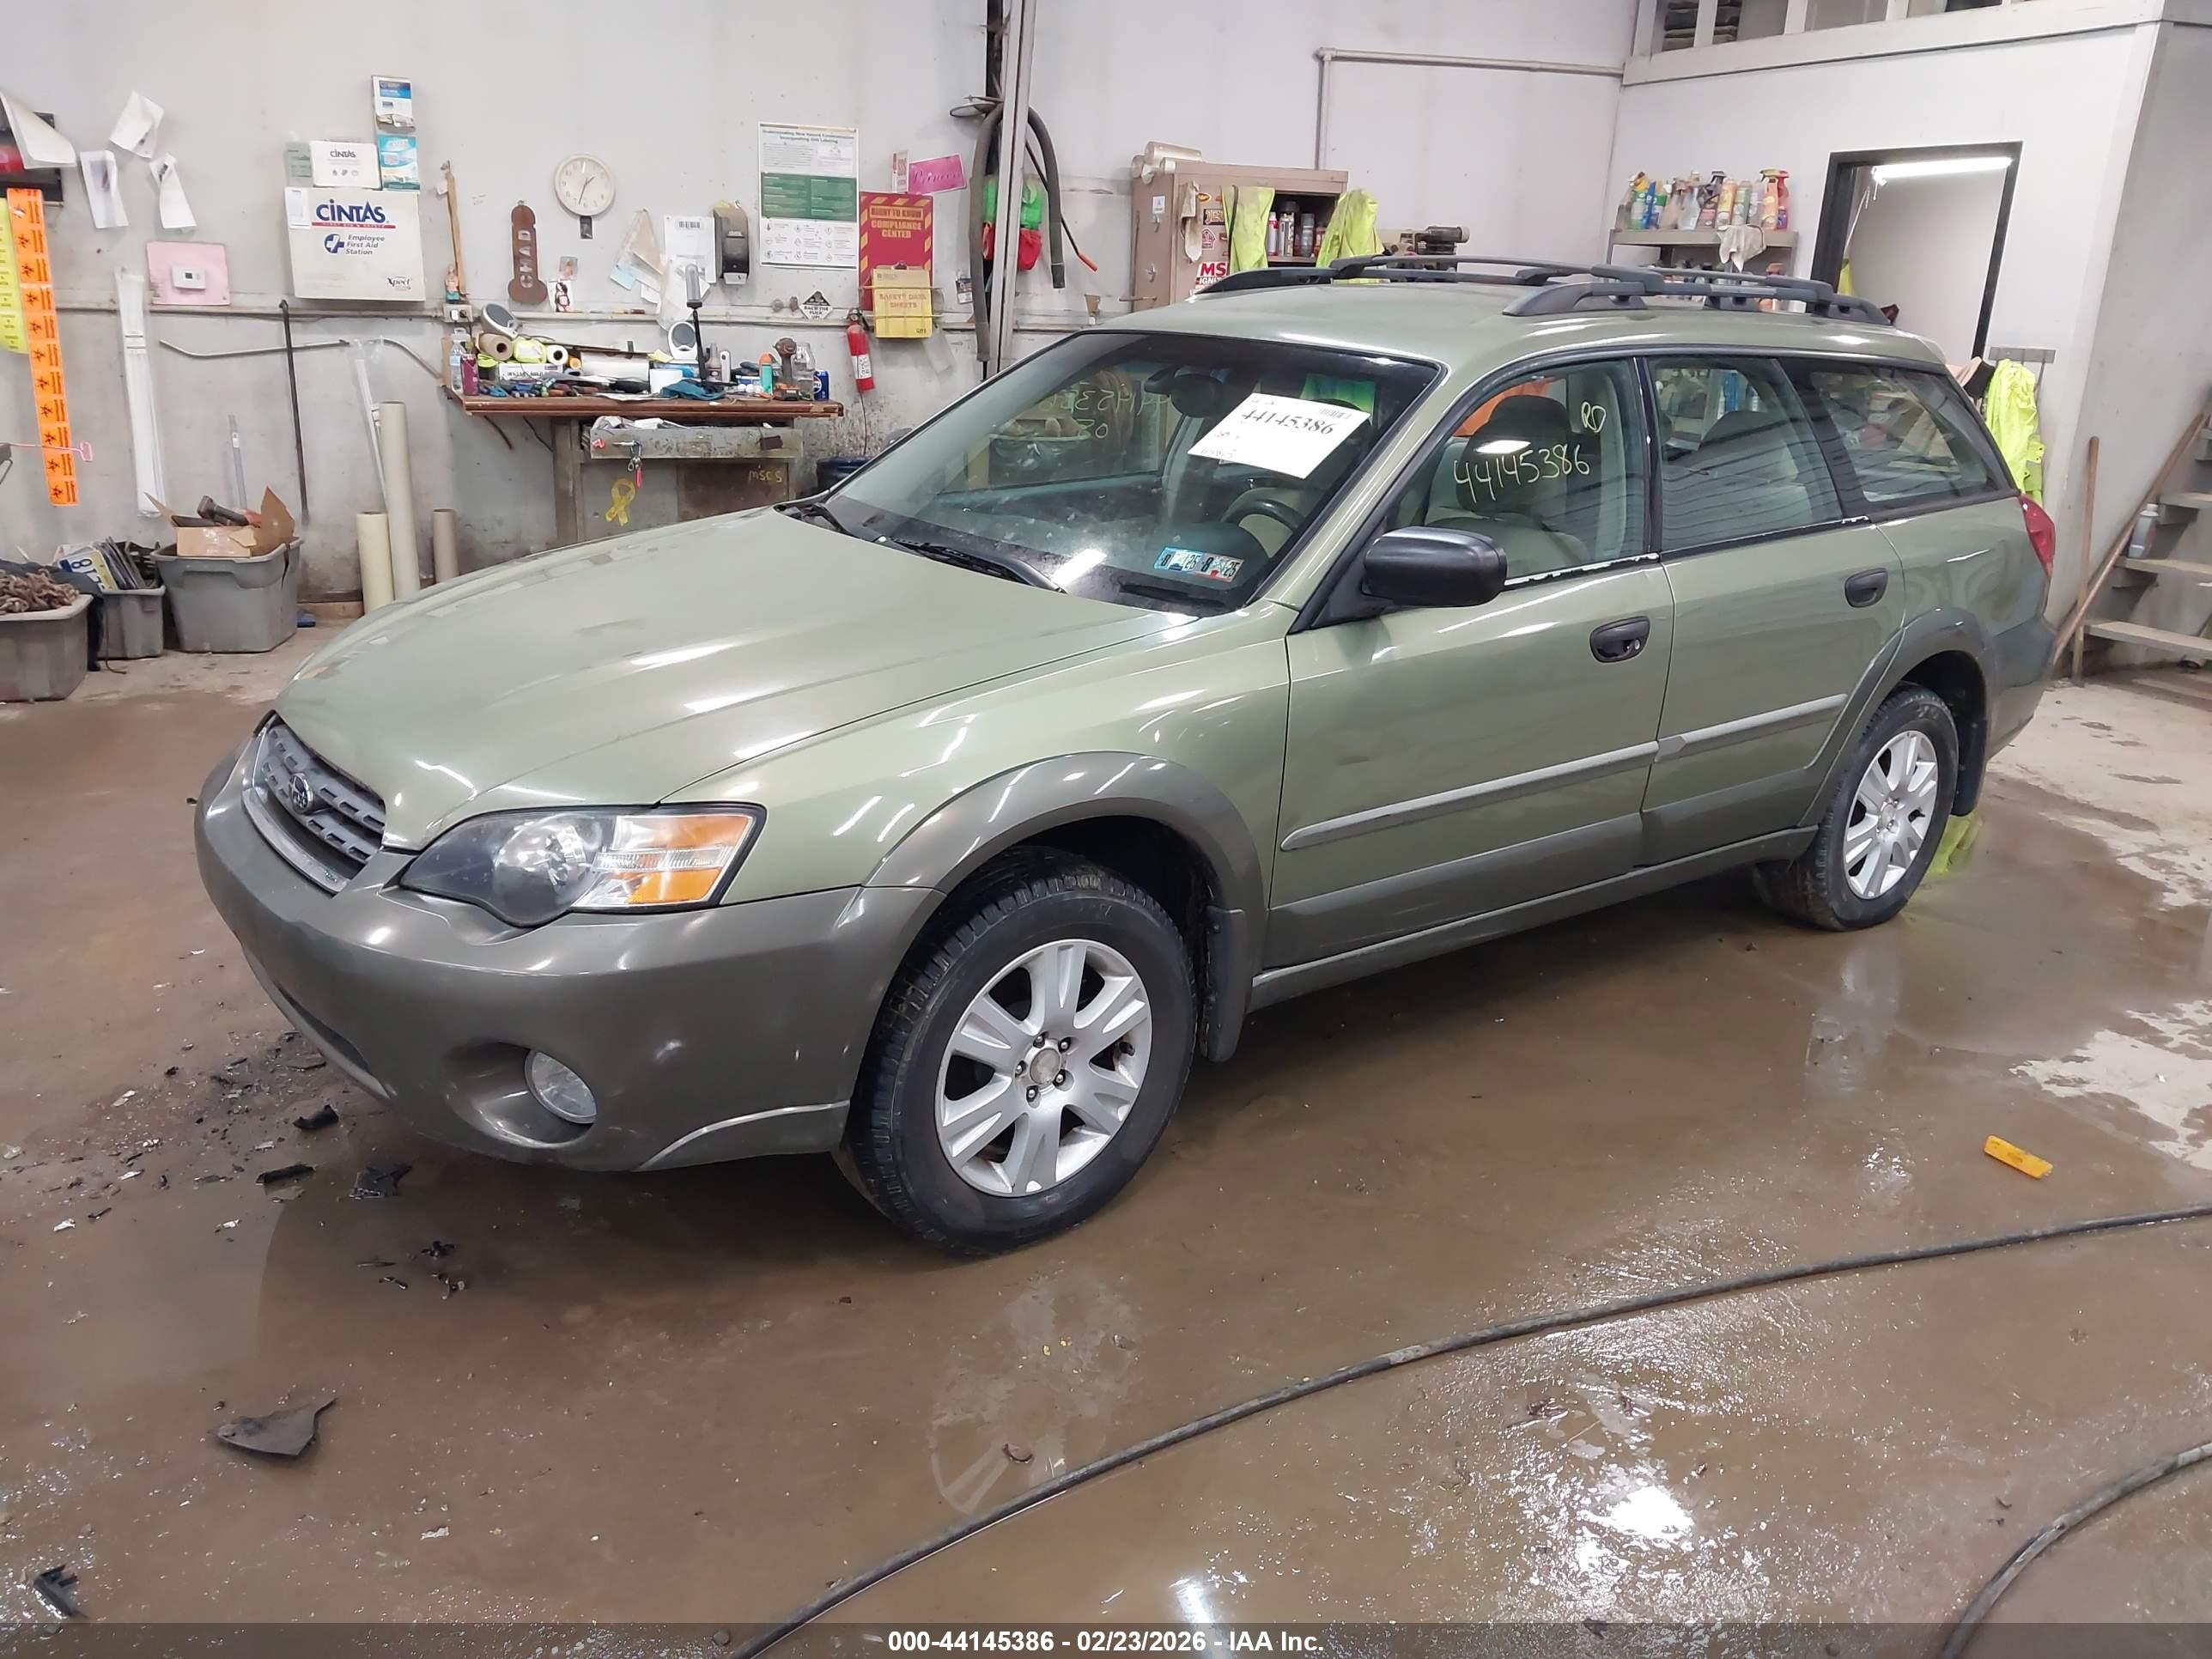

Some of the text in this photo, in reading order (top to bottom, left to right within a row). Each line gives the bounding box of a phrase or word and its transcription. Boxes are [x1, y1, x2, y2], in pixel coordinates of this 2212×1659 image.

[315, 198, 386, 223] CINTAS
[348, 234, 385, 243] Employee
[1242, 409, 1334, 435] 44145386
[1453, 443, 1590, 504] 44145386
[1200, 556, 1215, 572] 8
